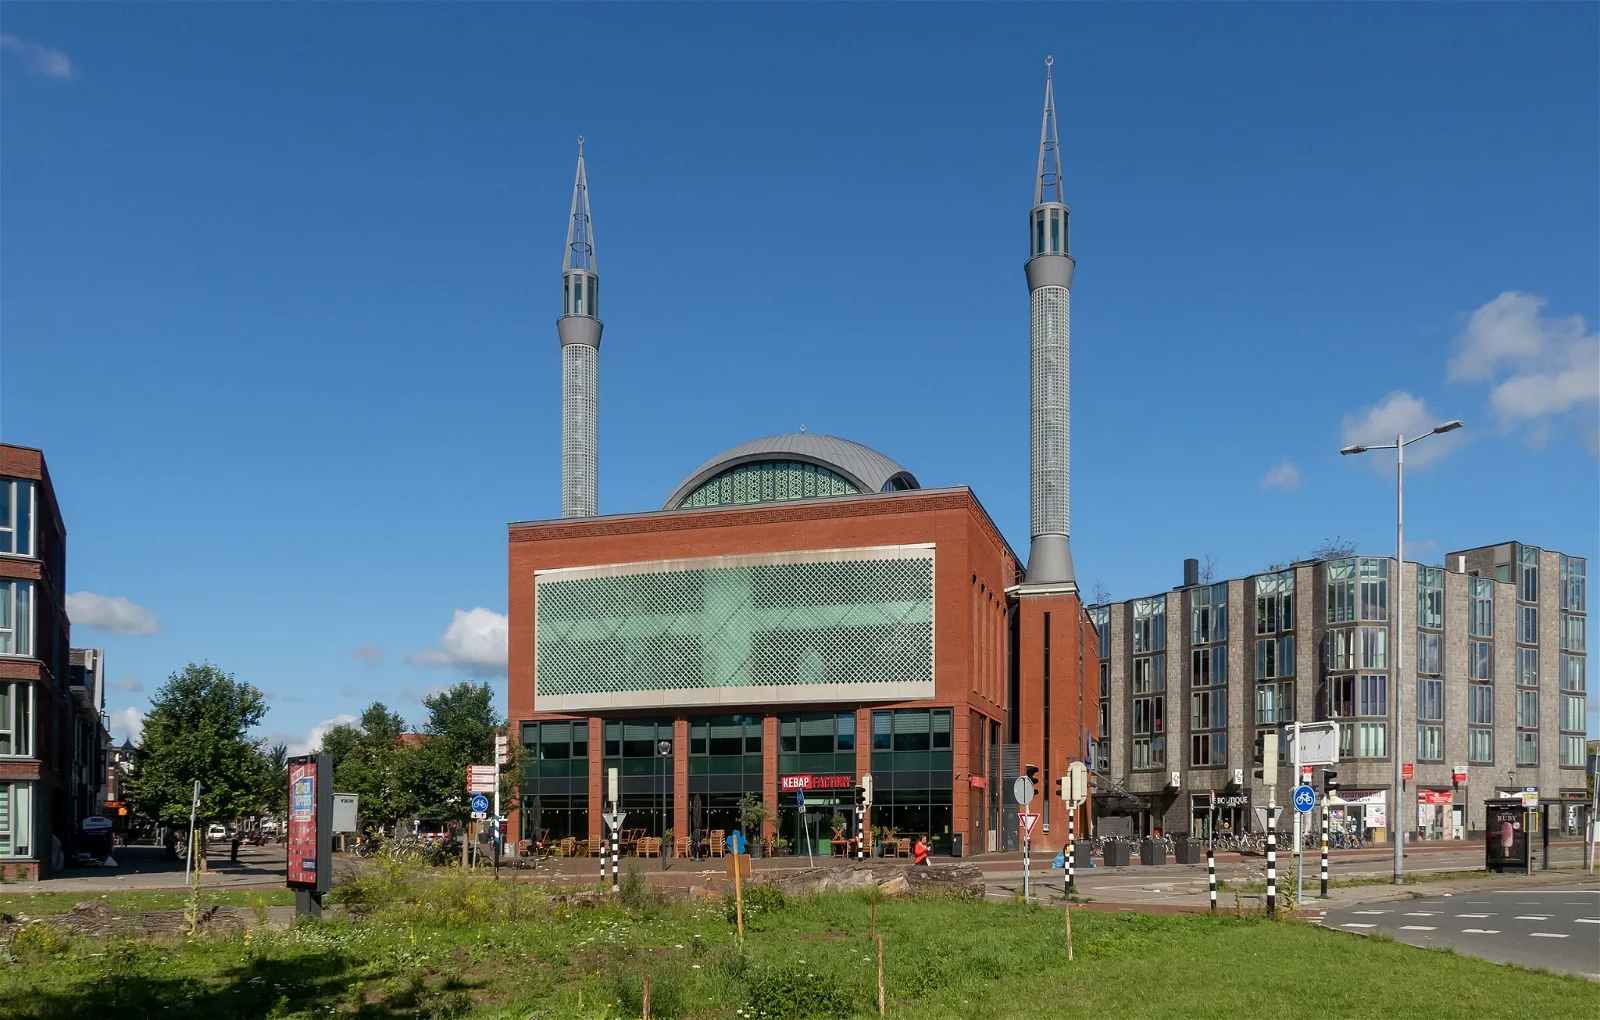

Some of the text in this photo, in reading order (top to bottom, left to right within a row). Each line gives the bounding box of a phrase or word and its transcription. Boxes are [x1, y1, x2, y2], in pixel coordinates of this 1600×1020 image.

[783, 776, 850, 788] KEBAP FACTORY
[1217, 796, 1248, 805] BOUTIQUE
